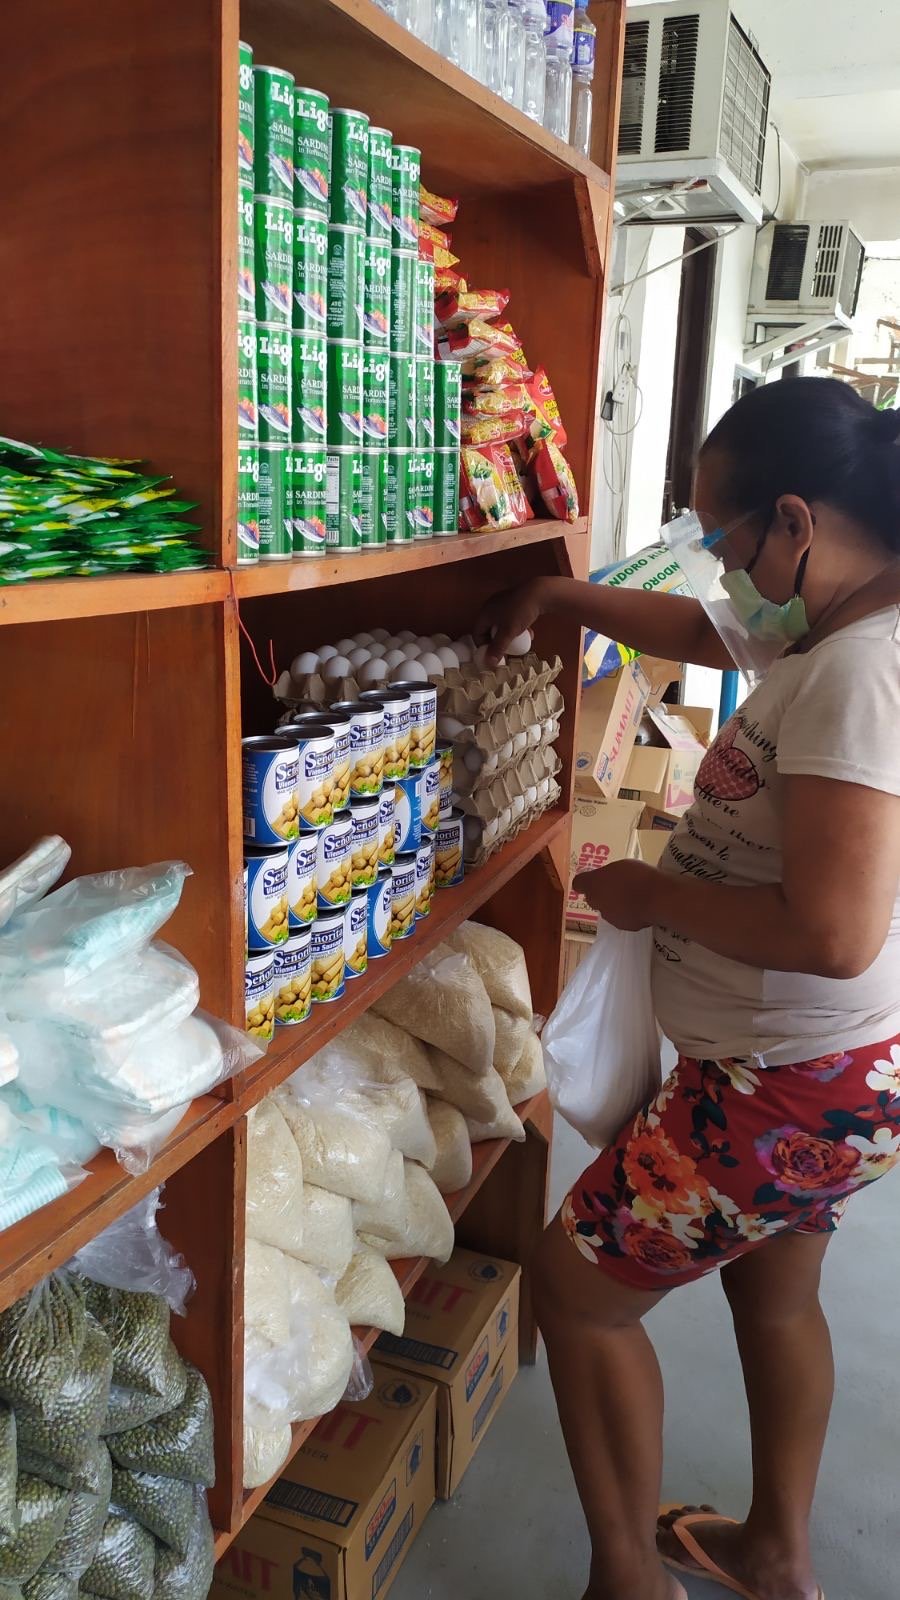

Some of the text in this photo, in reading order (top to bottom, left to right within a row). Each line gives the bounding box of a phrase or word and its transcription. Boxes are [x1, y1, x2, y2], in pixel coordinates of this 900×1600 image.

[271, 81, 294, 119] Lig
[347, 122, 369, 153] Lig
[371, 139, 392, 168] Lig
[265, 211, 293, 244] Lig
[416, 270, 434, 293] Lig
[259, 336, 291, 366] Lig
[300, 344, 327, 371] Lig
[238, 456, 259, 483] Lig
[608, 558, 649, 588] NDORO
[642, 561, 682, 592] NDORO
